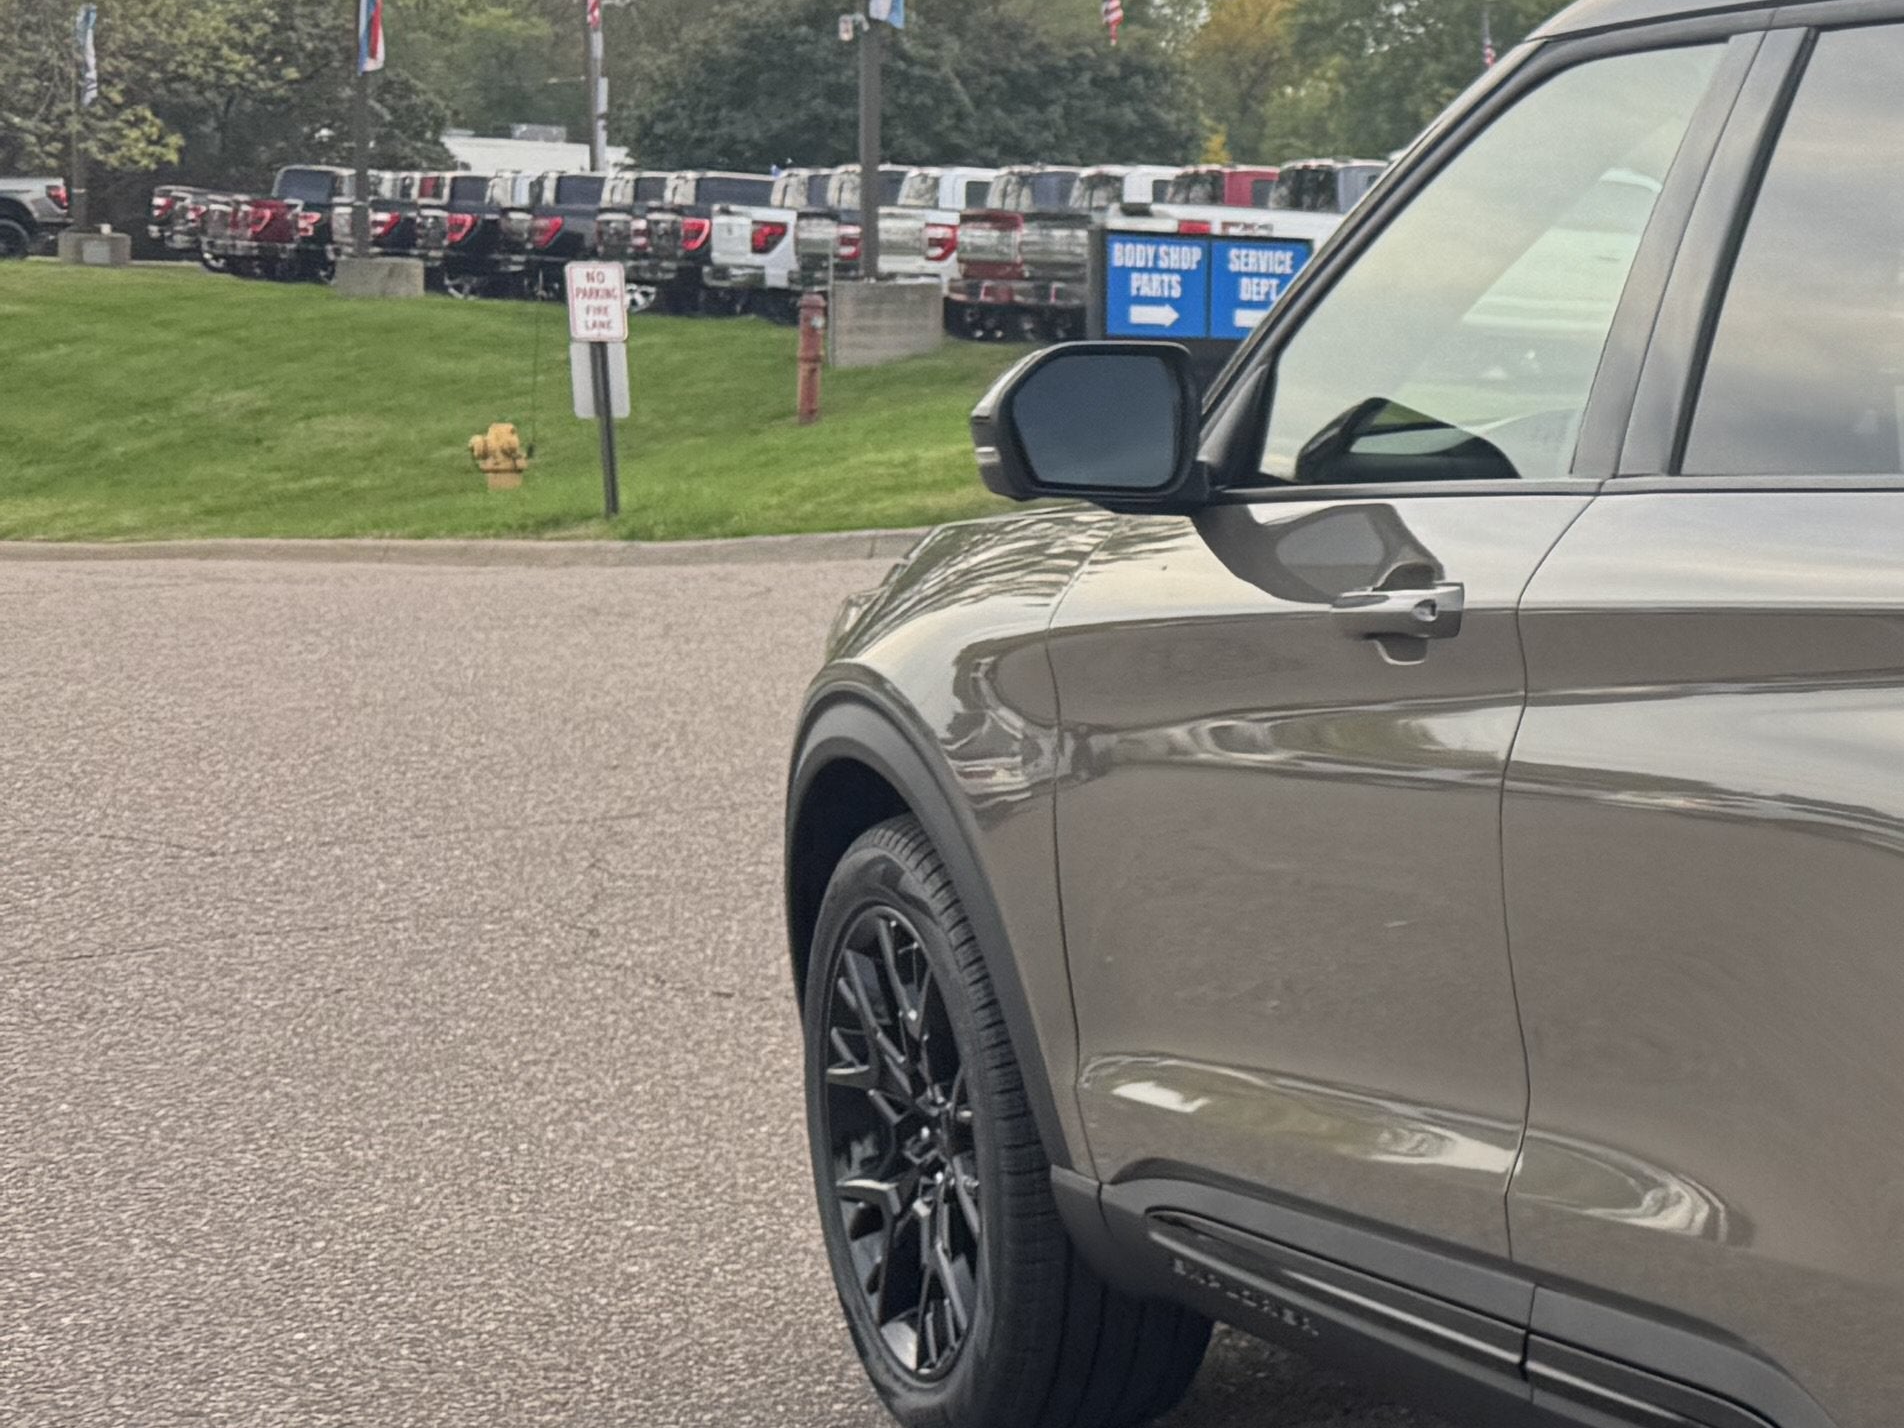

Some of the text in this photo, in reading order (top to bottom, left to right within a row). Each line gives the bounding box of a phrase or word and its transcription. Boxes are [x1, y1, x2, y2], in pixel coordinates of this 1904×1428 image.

[1113, 241, 1203, 271] BODY SHOP
[1228, 247, 1294, 274] SERVICE
[586, 271, 605, 284] NO
[1130, 272, 1182, 299] PARTS
[575, 287, 618, 300] PARKING
[586, 305, 609, 316] FIRE
[585, 320, 612, 331] LANE
